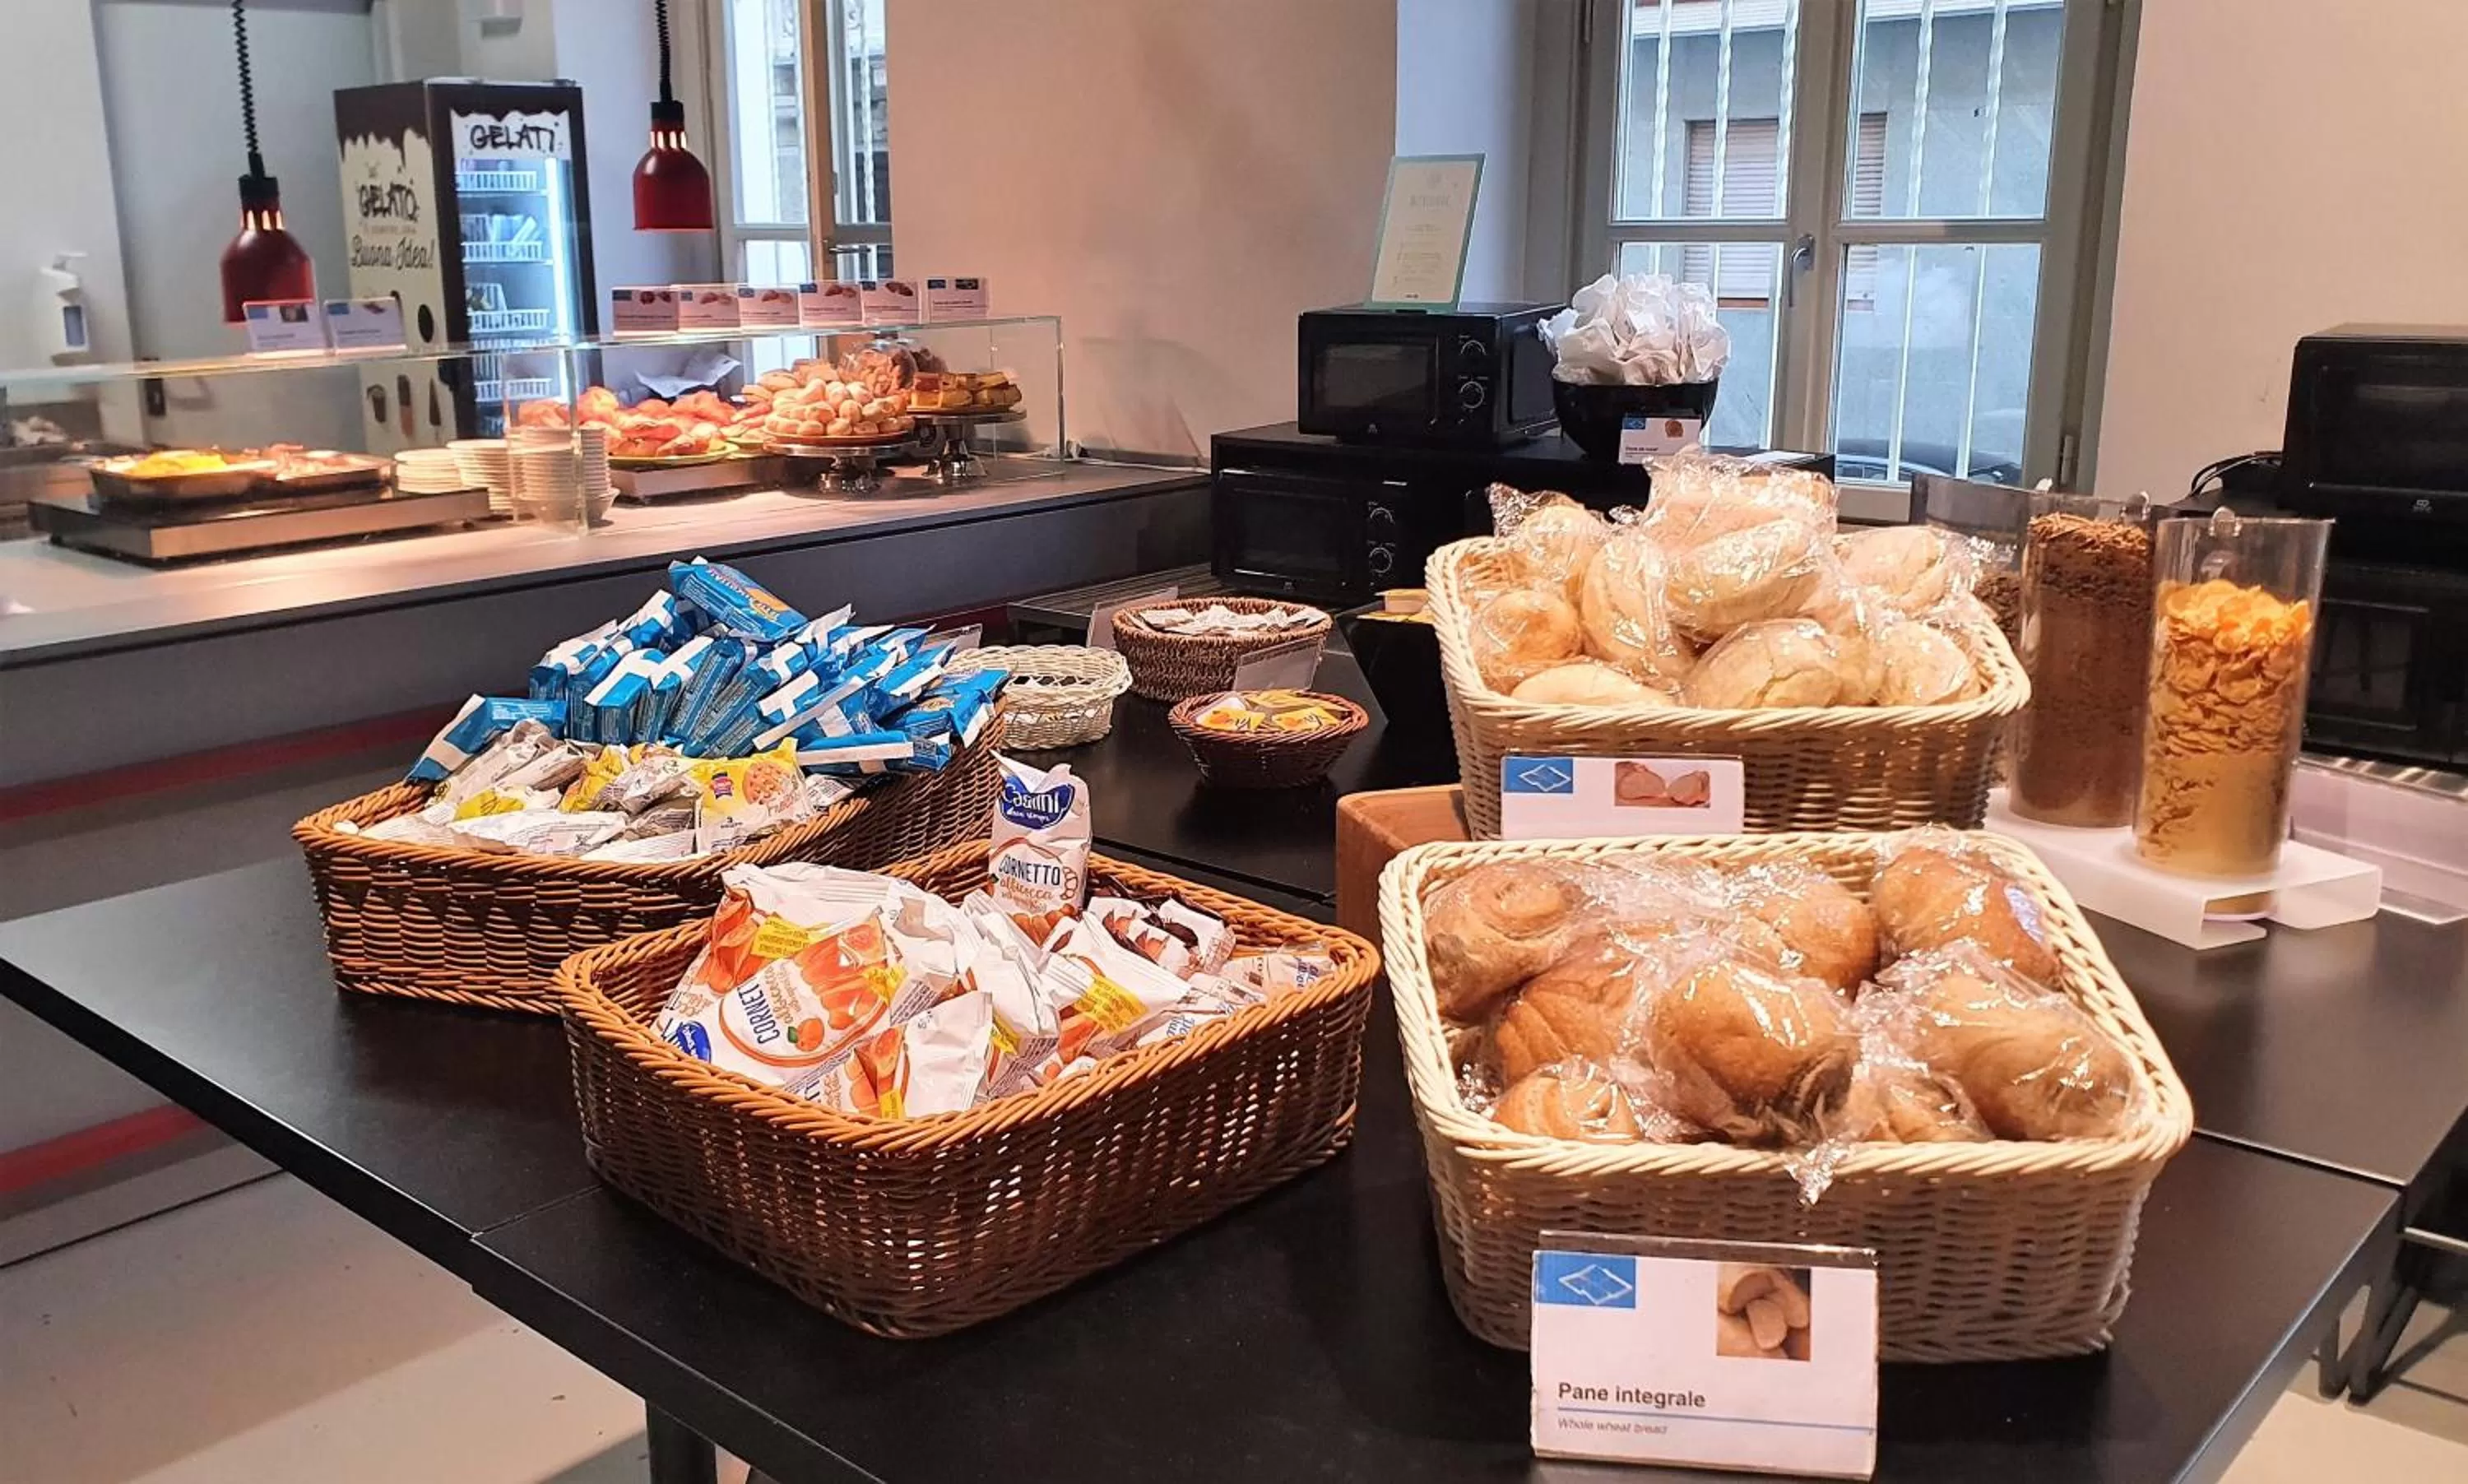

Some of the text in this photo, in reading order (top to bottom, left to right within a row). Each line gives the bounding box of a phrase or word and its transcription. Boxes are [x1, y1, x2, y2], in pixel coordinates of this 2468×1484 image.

[470, 123, 559, 152] GELATI
[359, 182, 420, 221] GELATO
[998, 854, 1061, 886] CORNETTO
[1558, 1383, 1706, 1409] Pane integrale
[1557, 1417, 1594, 1431] Whole
[1597, 1419, 1631, 1433] wheat
